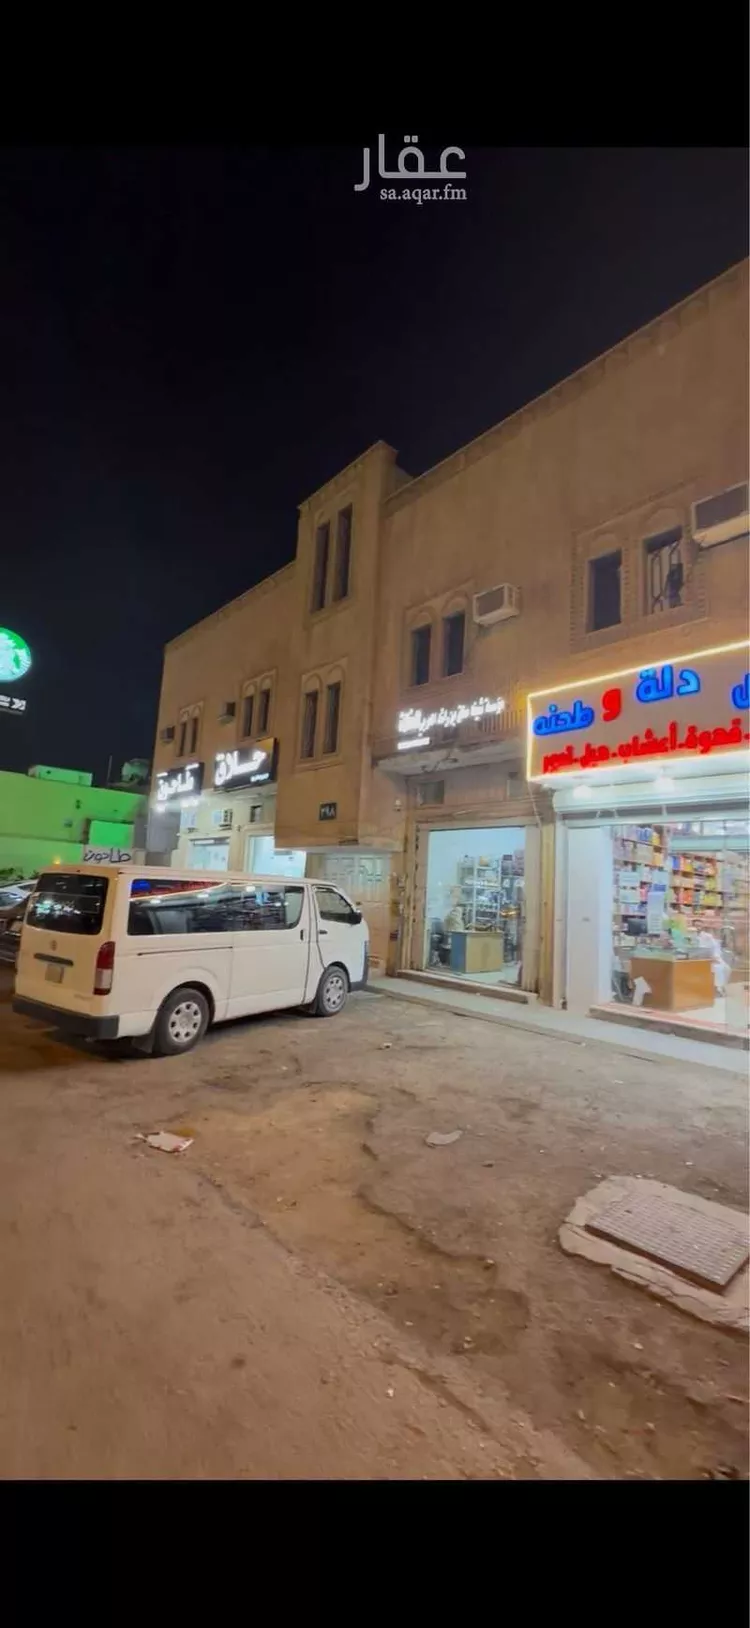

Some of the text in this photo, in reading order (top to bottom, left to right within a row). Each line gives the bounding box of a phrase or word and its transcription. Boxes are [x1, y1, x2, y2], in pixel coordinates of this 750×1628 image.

[635, 664, 701, 703] دلة
[601, 688, 622, 722] و
[214, 750, 267, 786] حلاق
